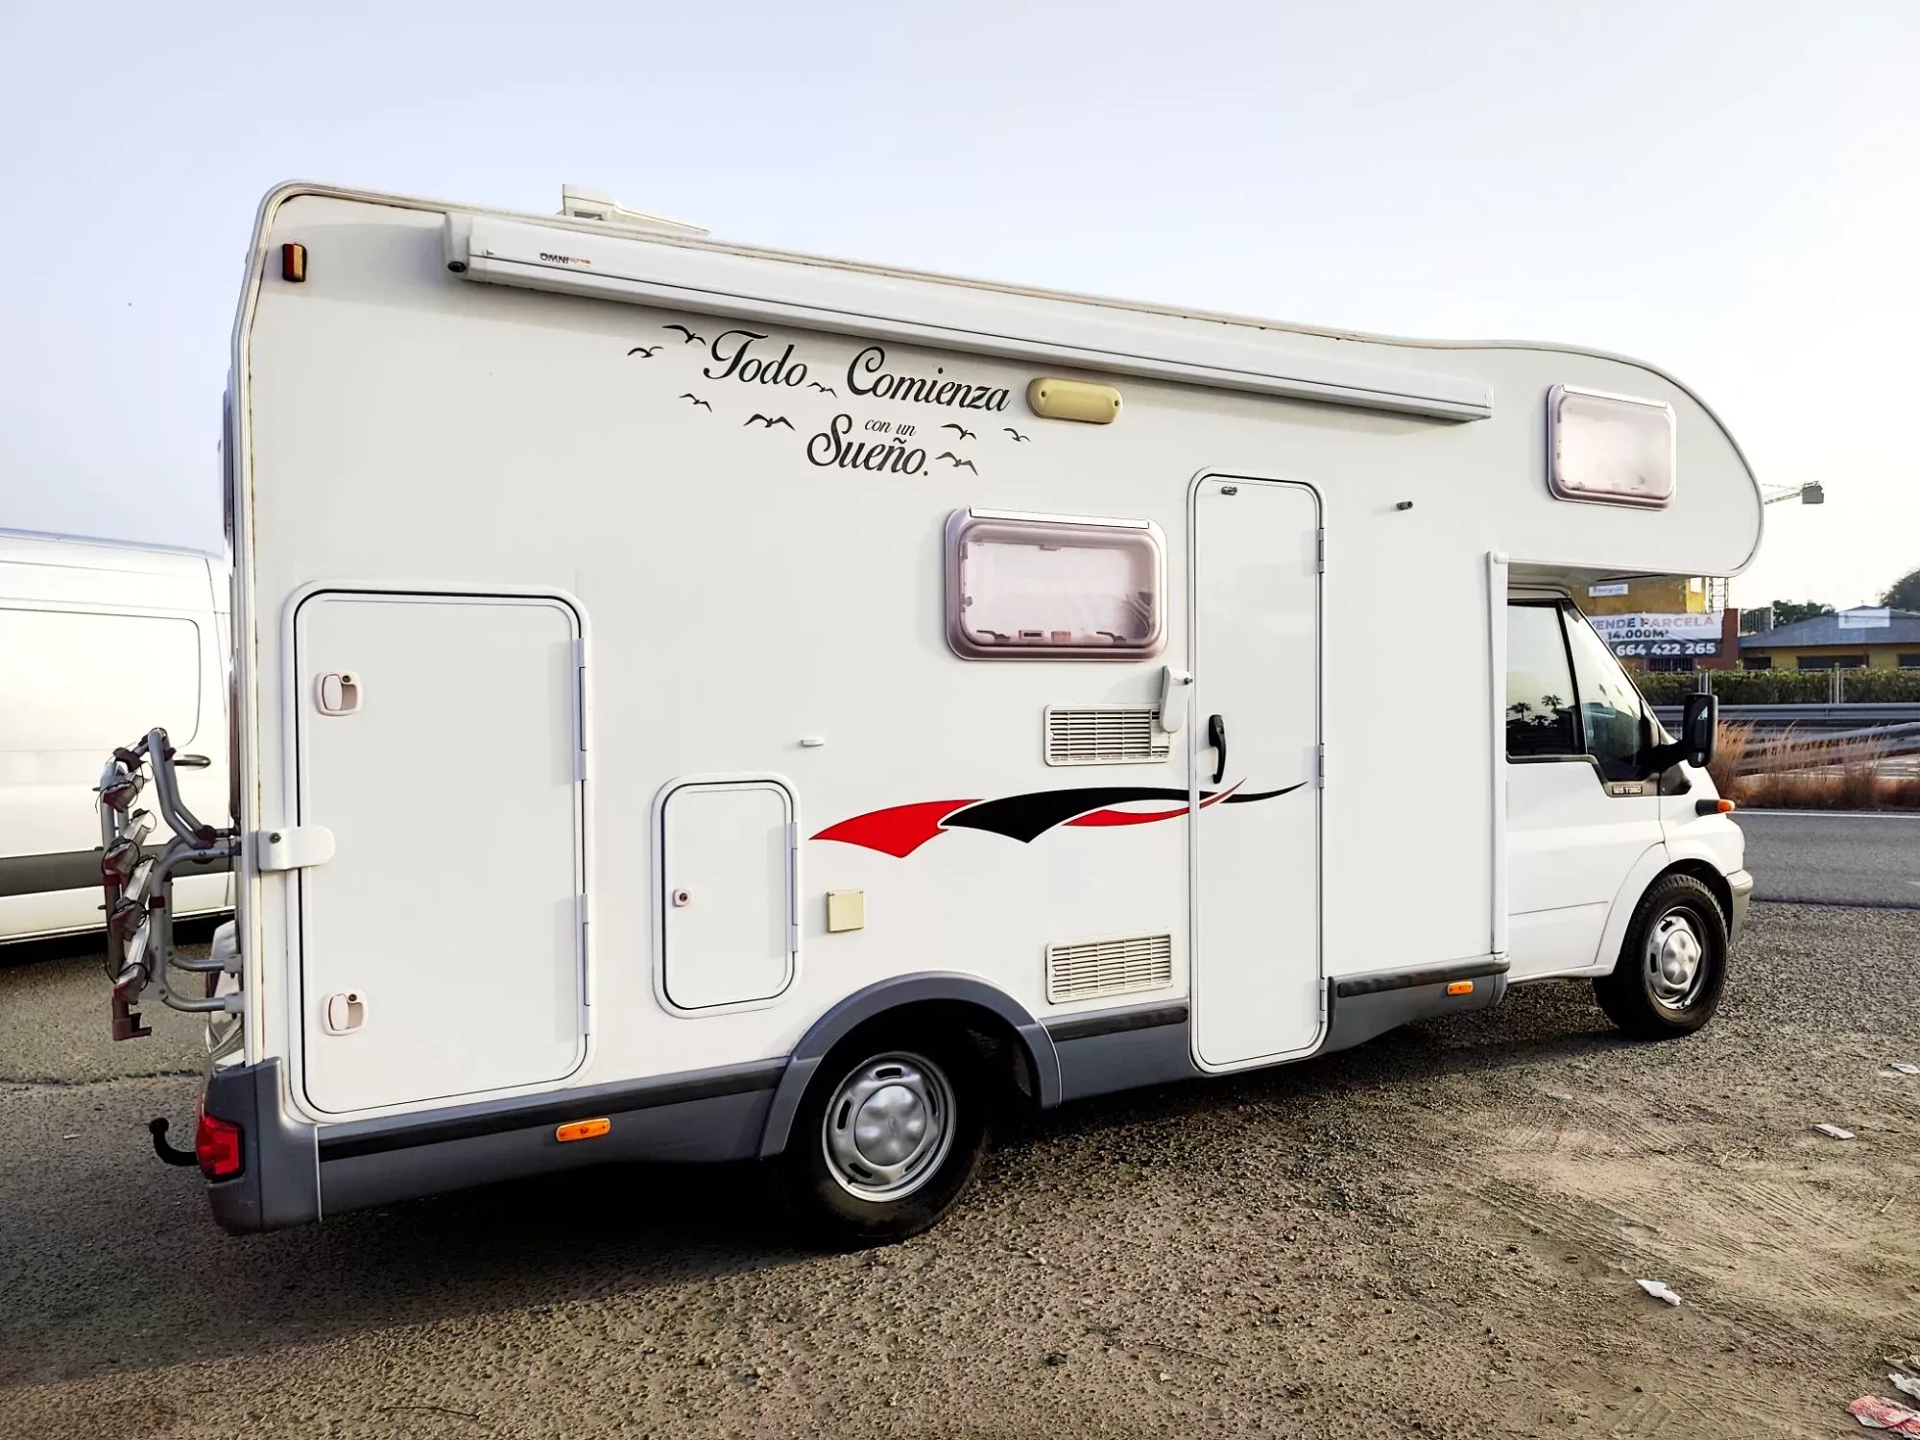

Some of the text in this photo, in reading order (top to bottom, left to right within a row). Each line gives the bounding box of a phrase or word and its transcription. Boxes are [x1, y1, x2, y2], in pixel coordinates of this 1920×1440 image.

[703, 329, 1011, 412] Todo Comienza
[864, 419, 916, 437] con un
[806, 413, 929, 477] Sueño.
[1640, 616, 1715, 628] PARCELA
[1616, 642, 1716, 657] 664 422 265
